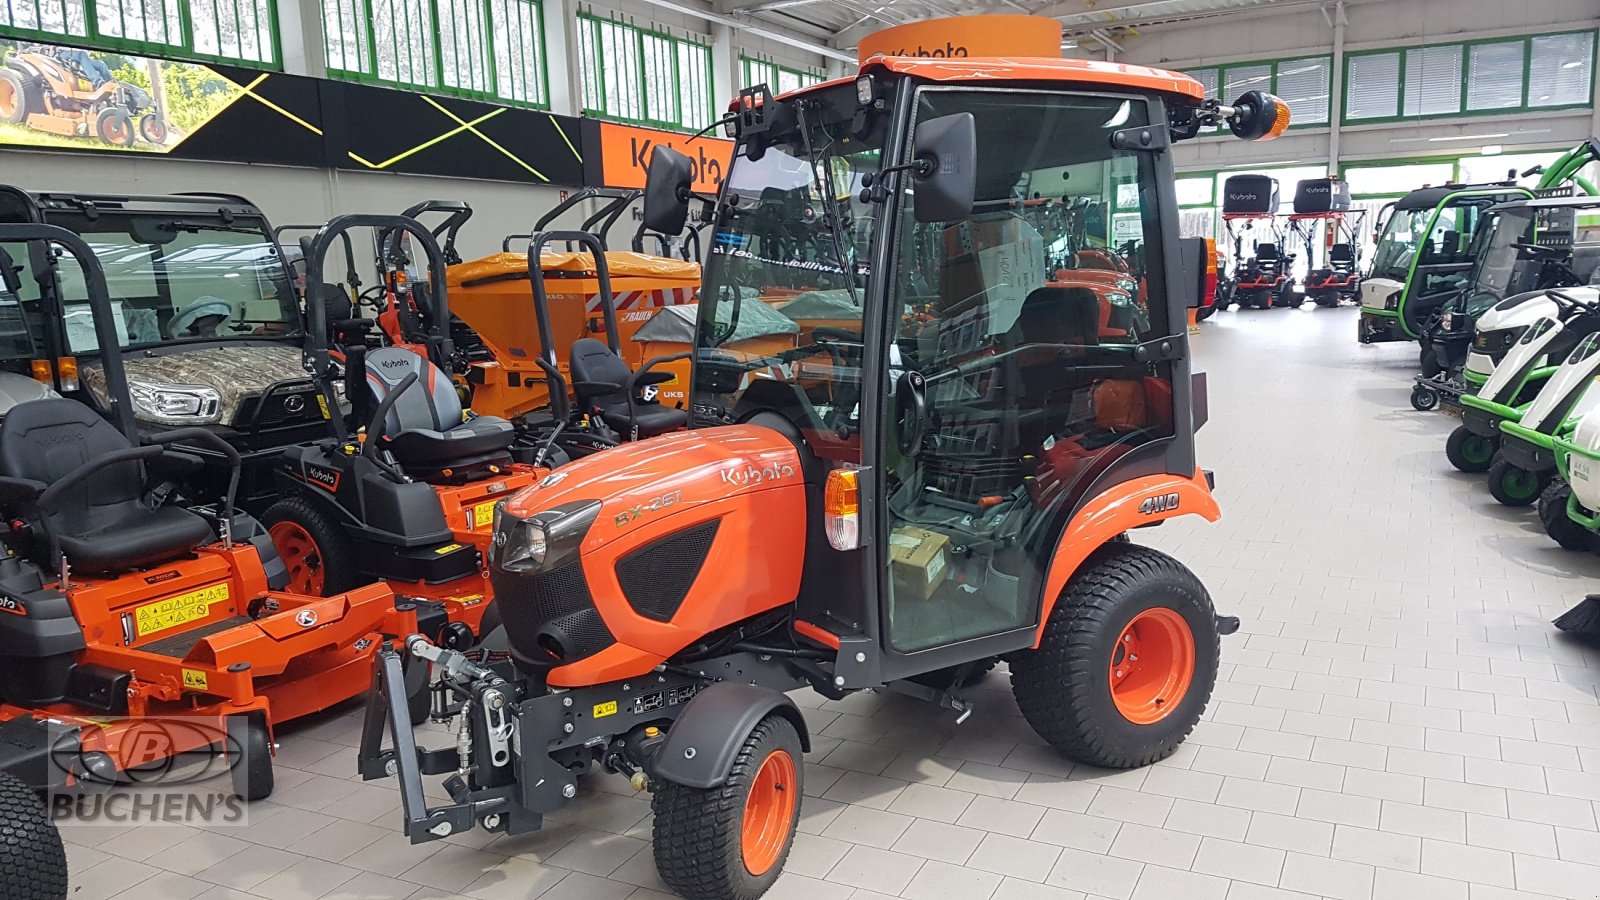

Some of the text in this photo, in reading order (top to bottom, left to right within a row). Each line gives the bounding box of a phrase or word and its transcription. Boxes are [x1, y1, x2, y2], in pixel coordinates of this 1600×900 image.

[892, 42, 968, 57] bota
[631, 137, 721, 184] Kota
[1230, 193, 1257, 201] Kubota
[381, 358, 409, 368] Kubota
[592, 441, 614, 450] Kubo
[310, 467, 335, 484] Kubota
[720, 461, 794, 486] Kubota
[614, 489, 682, 528] BX-261
[1138, 493, 1179, 515] 4WD
